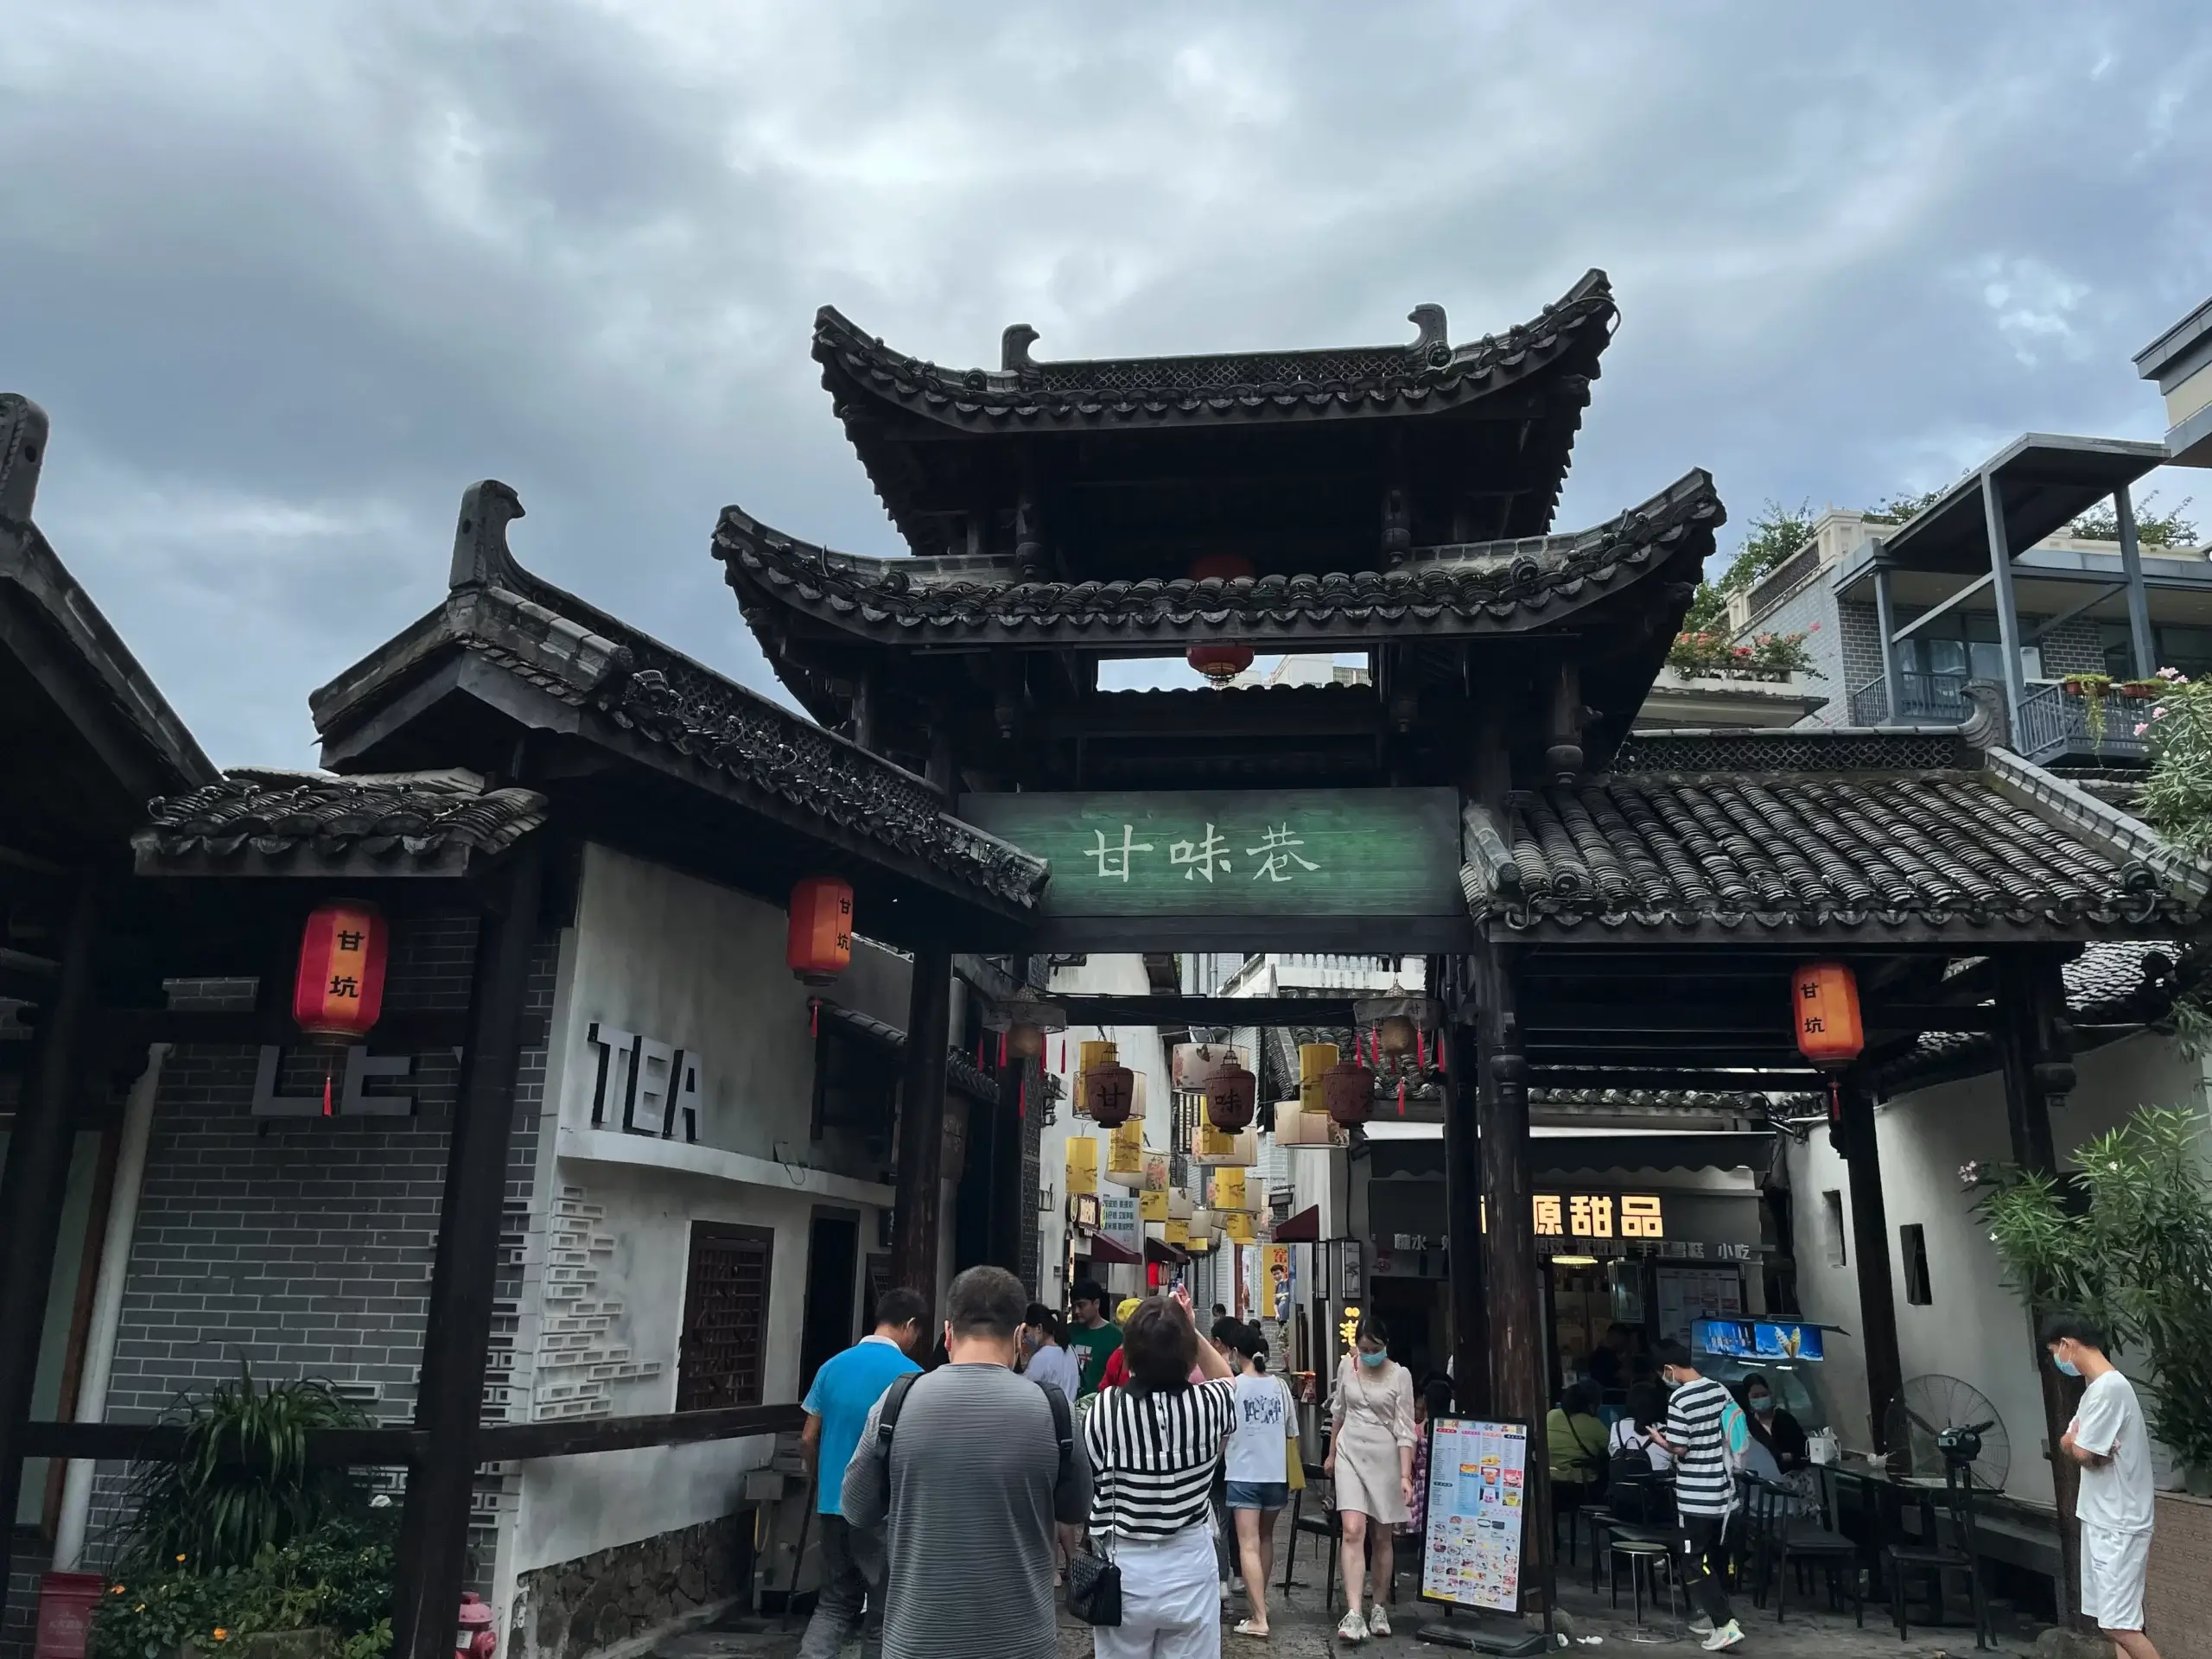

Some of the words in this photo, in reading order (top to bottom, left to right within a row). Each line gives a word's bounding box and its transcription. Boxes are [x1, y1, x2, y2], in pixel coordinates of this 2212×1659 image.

[1083, 822, 1321, 883] 甘味巷
[836, 898, 851, 950] 甘坑
[329, 930, 365, 998] 甘坑
[1801, 982, 1825, 1033] 甘坑
[588, 1023, 702, 1142] TEA
[1096, 1083, 1124, 1109] 甘
[1481, 1195, 1663, 1237] 原甜品
[1717, 1243, 1751, 1260] 小吃
